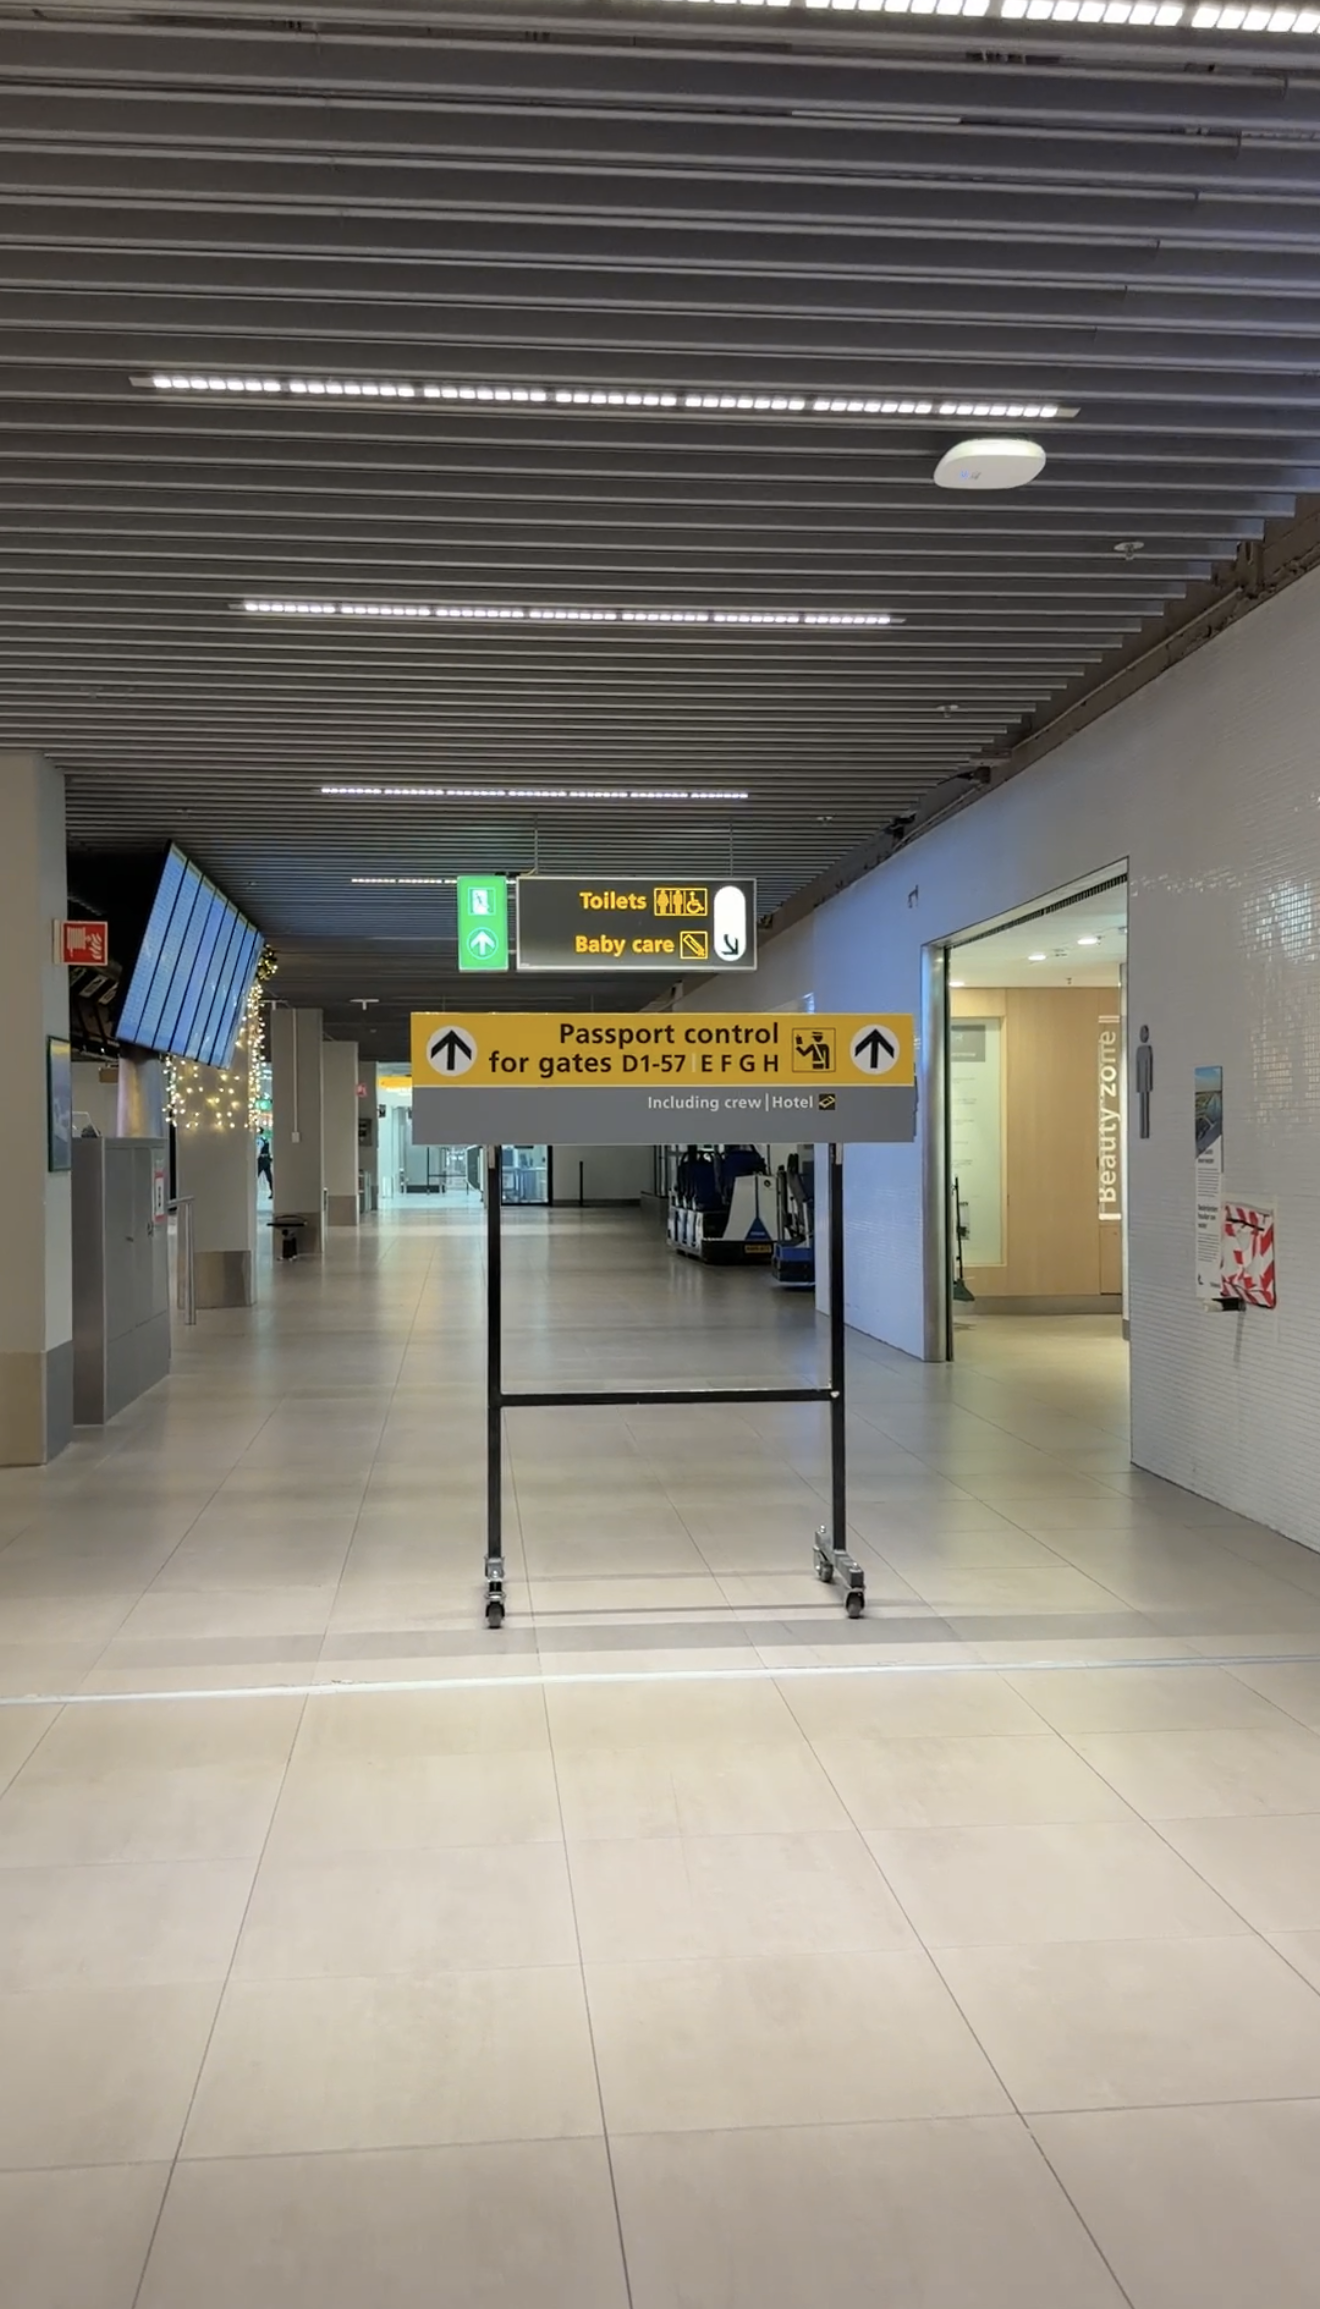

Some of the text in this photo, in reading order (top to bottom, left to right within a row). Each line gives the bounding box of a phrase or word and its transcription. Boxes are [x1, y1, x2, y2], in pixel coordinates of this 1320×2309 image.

[579, 891, 647, 910] Toilets
[575, 935, 675, 956] Baby care
[560, 1022, 779, 1048] Passport control
[489, 1051, 779, 1078] for gates D1-57 E F G H
[647, 1094, 814, 1112] Including crew Hotel
[1099, 1030, 1121, 1203] Beauty zone
